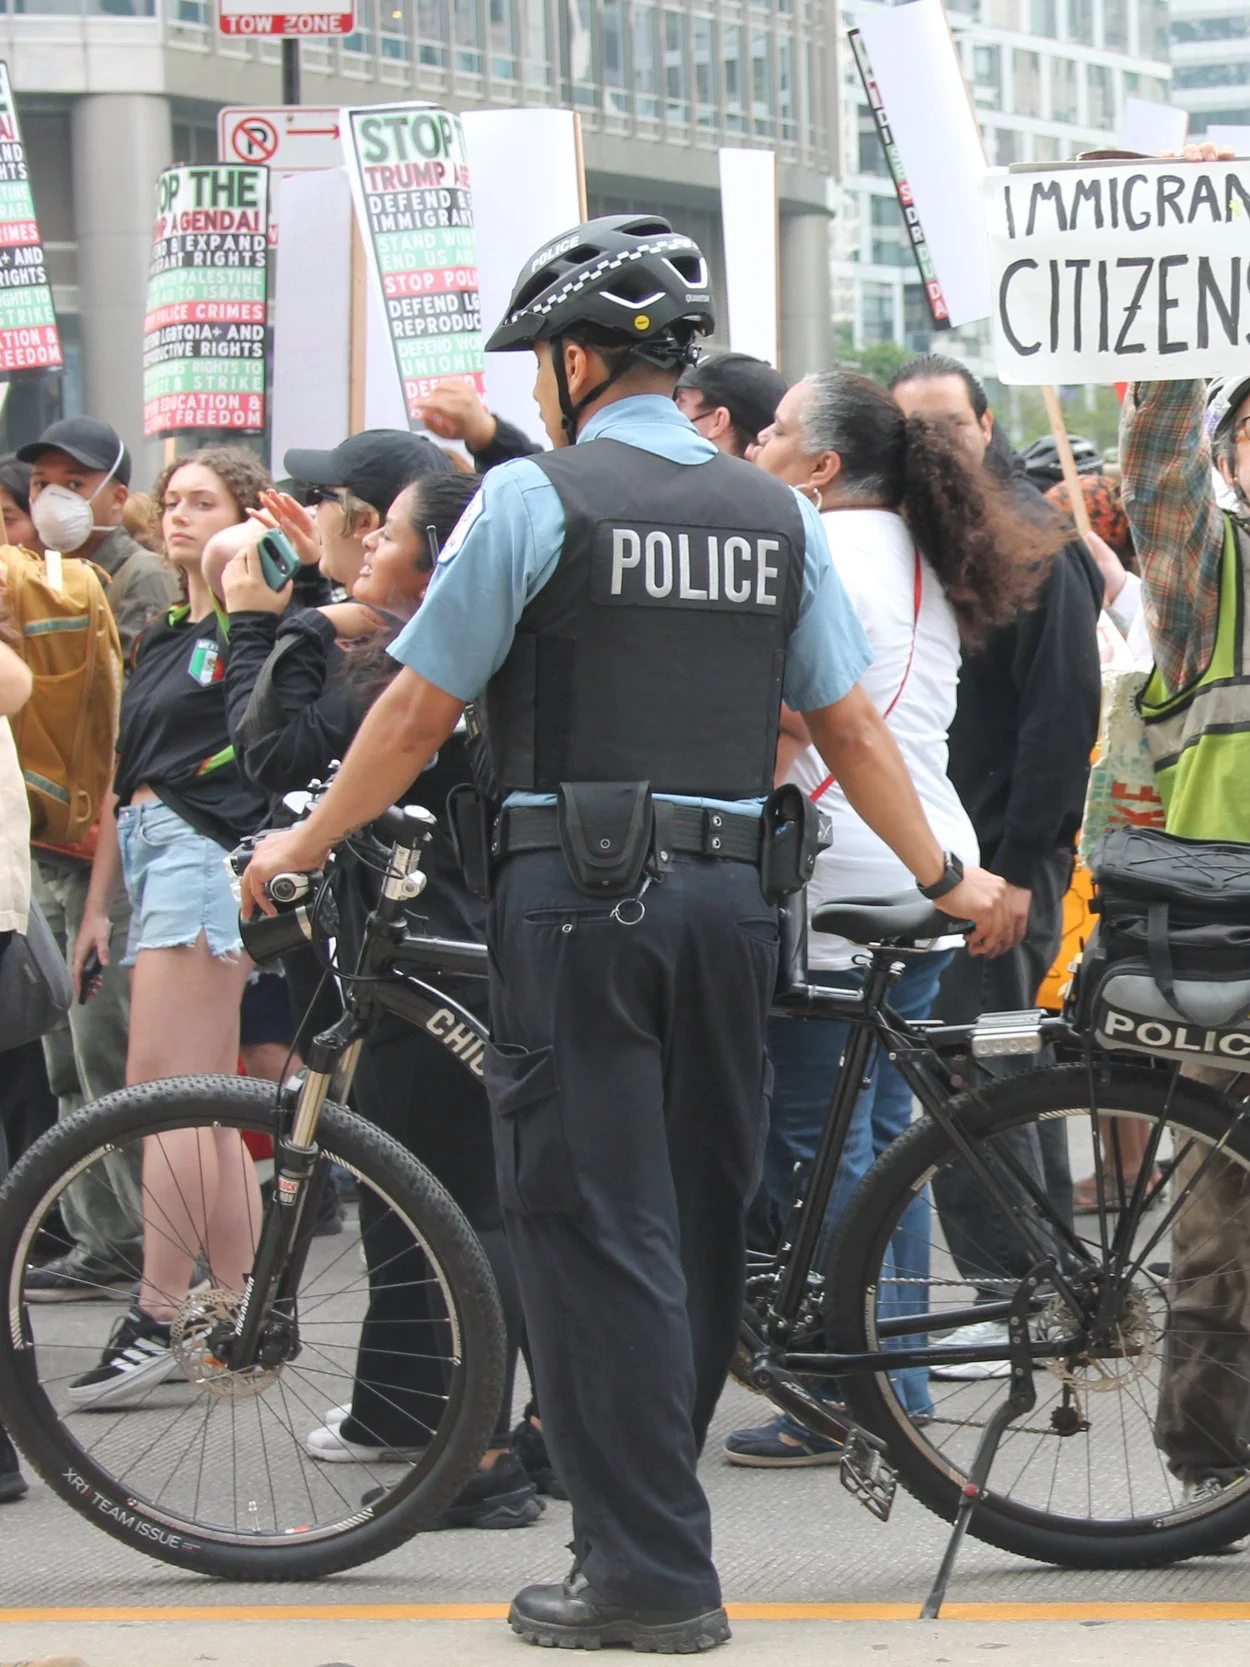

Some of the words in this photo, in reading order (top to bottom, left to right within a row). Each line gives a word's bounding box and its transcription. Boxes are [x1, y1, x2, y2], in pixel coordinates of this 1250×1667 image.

[226, 15, 273, 32] TOW
[284, 15, 341, 32] ZONE
[359, 115, 453, 163] STOP
[363, 162, 445, 191] TRUMP
[189, 170, 259, 208] THE
[369, 190, 451, 215] DEFEND
[171, 209, 260, 232] AGENDA!
[185, 234, 266, 252] EXPAND
[14, 247, 44, 266] AND
[193, 252, 266, 267] RIGHTS
[531, 236, 582, 272] POLICE
[384, 274, 434, 294] STOP
[195, 304, 264, 320] CRIMES
[389, 293, 459, 319] DEFEND
[45, 328, 57, 344] &
[227, 324, 265, 341] AND
[201, 342, 263, 358] RIGHTS
[248, 396, 262, 410] &
[176, 411, 262, 426] FREEDOM
[611, 528, 779, 606] POLICE
[62, 1467, 90, 1495] XR1
[91, 1491, 136, 1528] TEAM
[134, 1521, 183, 1549] ISSUE
